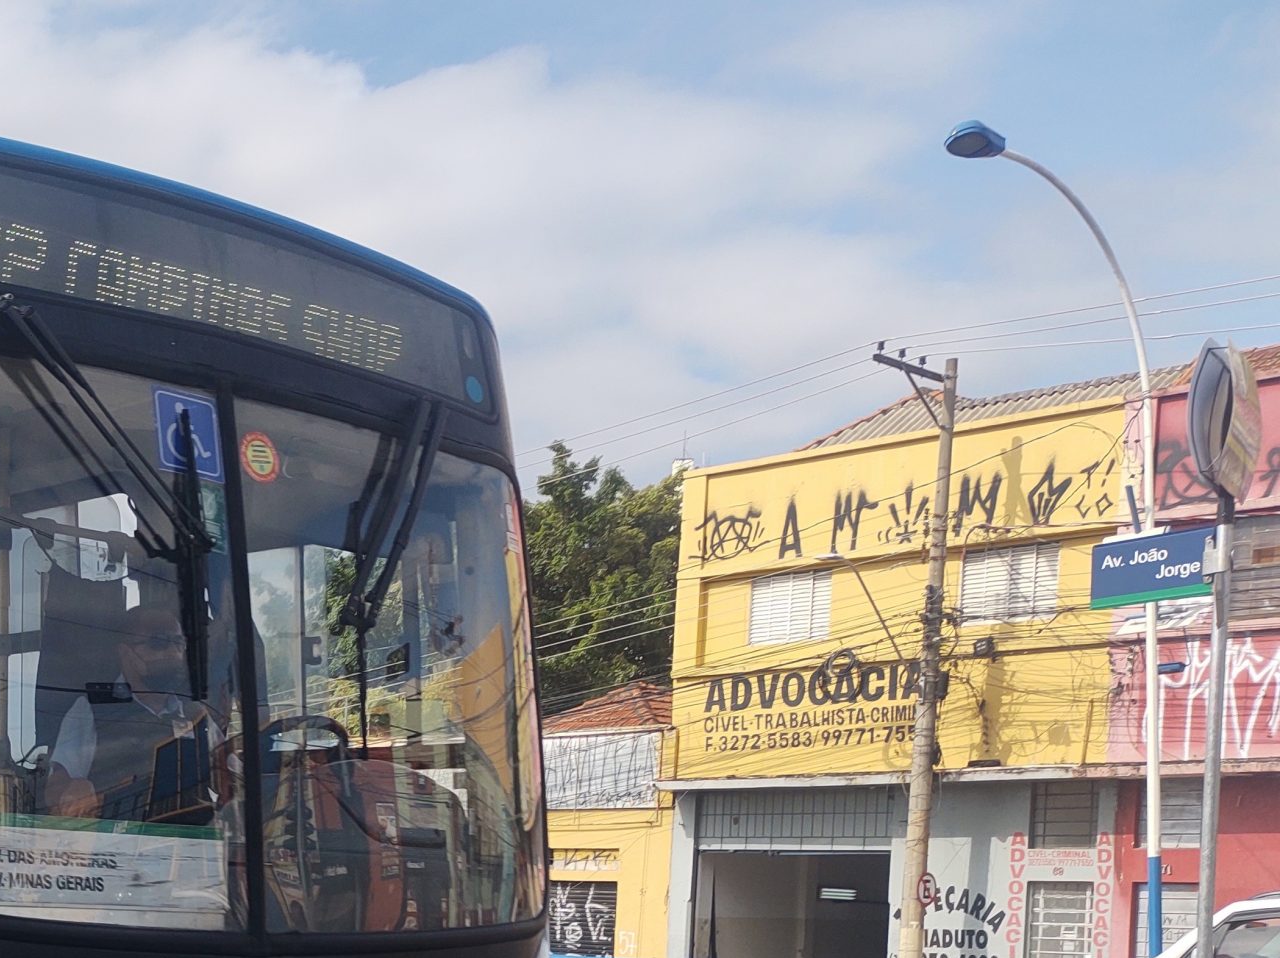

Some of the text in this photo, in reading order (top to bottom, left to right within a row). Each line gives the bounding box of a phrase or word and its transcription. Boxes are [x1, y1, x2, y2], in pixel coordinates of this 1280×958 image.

[1101, 548, 1168, 570] Av. João
[1155, 561, 1201, 579] Jorge
[703, 662, 924, 713] ADVOCACIA
[7, 849, 35, 864] DAS
[9, 872, 52, 890] MINAS
[56, 874, 105, 893] GERAIS
